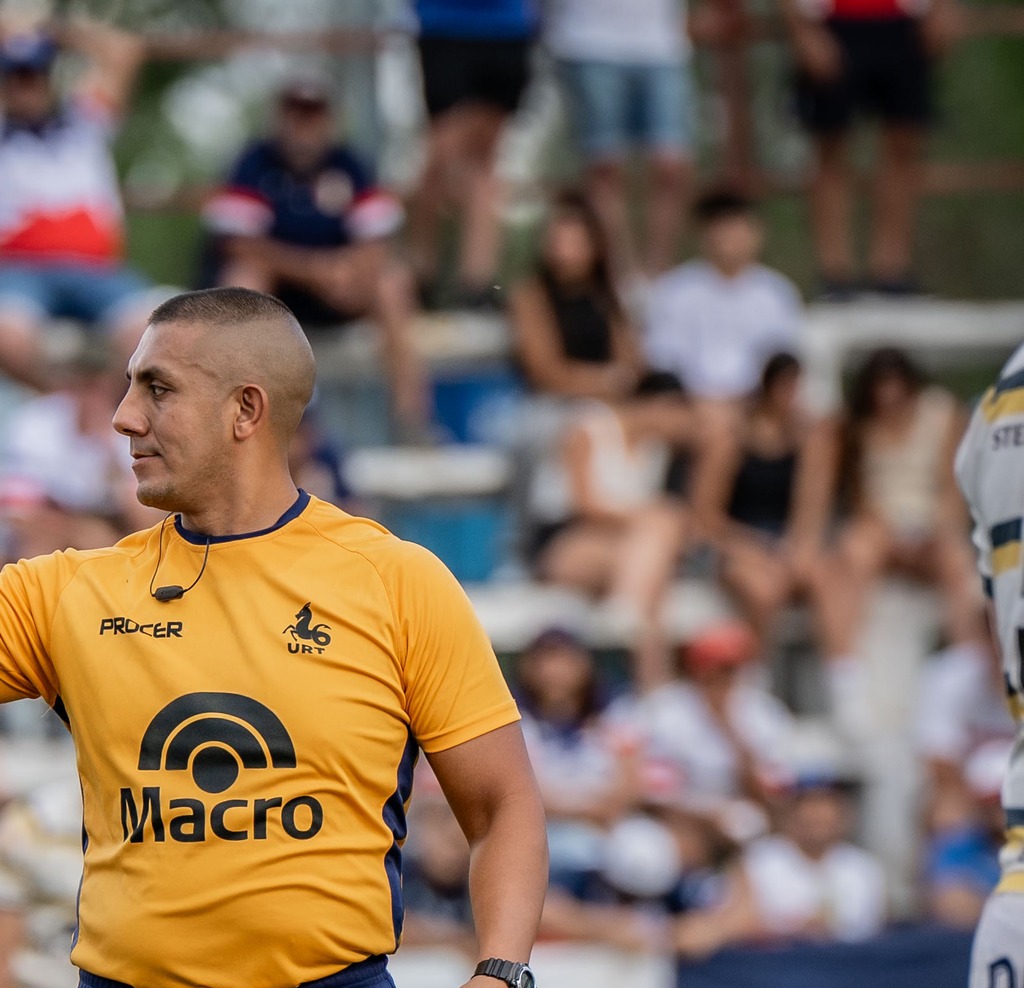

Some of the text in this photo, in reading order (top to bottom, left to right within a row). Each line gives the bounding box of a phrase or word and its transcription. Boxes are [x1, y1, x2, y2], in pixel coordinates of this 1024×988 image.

[99, 616, 183, 638] PROCER
[286, 642, 326, 655] URT
[119, 786, 325, 843] Macro
